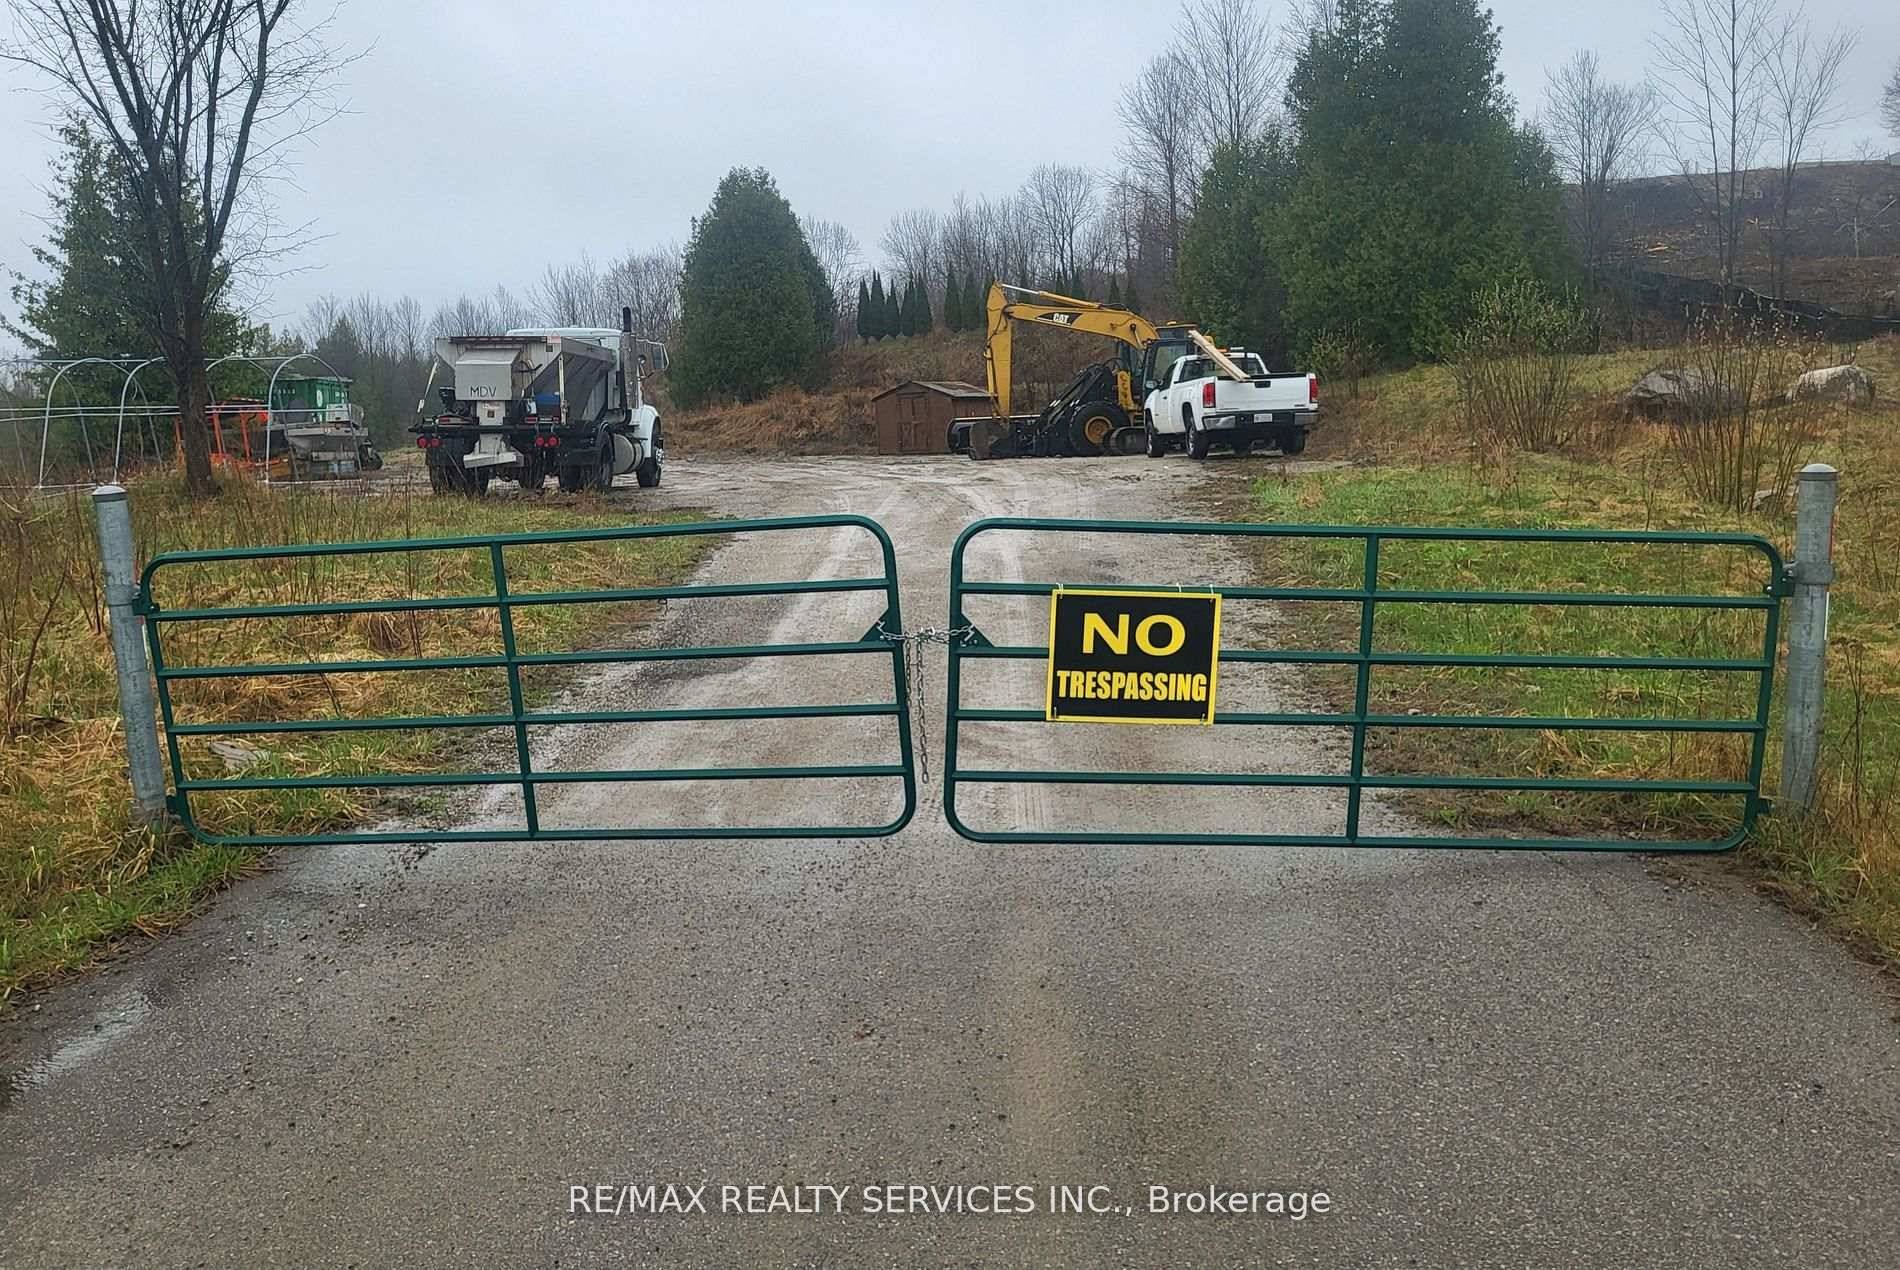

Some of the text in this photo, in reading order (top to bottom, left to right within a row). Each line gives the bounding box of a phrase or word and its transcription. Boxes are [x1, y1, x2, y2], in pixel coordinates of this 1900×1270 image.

[1053, 312, 1070, 324] CAT
[470, 385, 497, 398] MDV
[1082, 612, 1186, 656] NO
[1056, 670, 1208, 702] TRESPASSING
